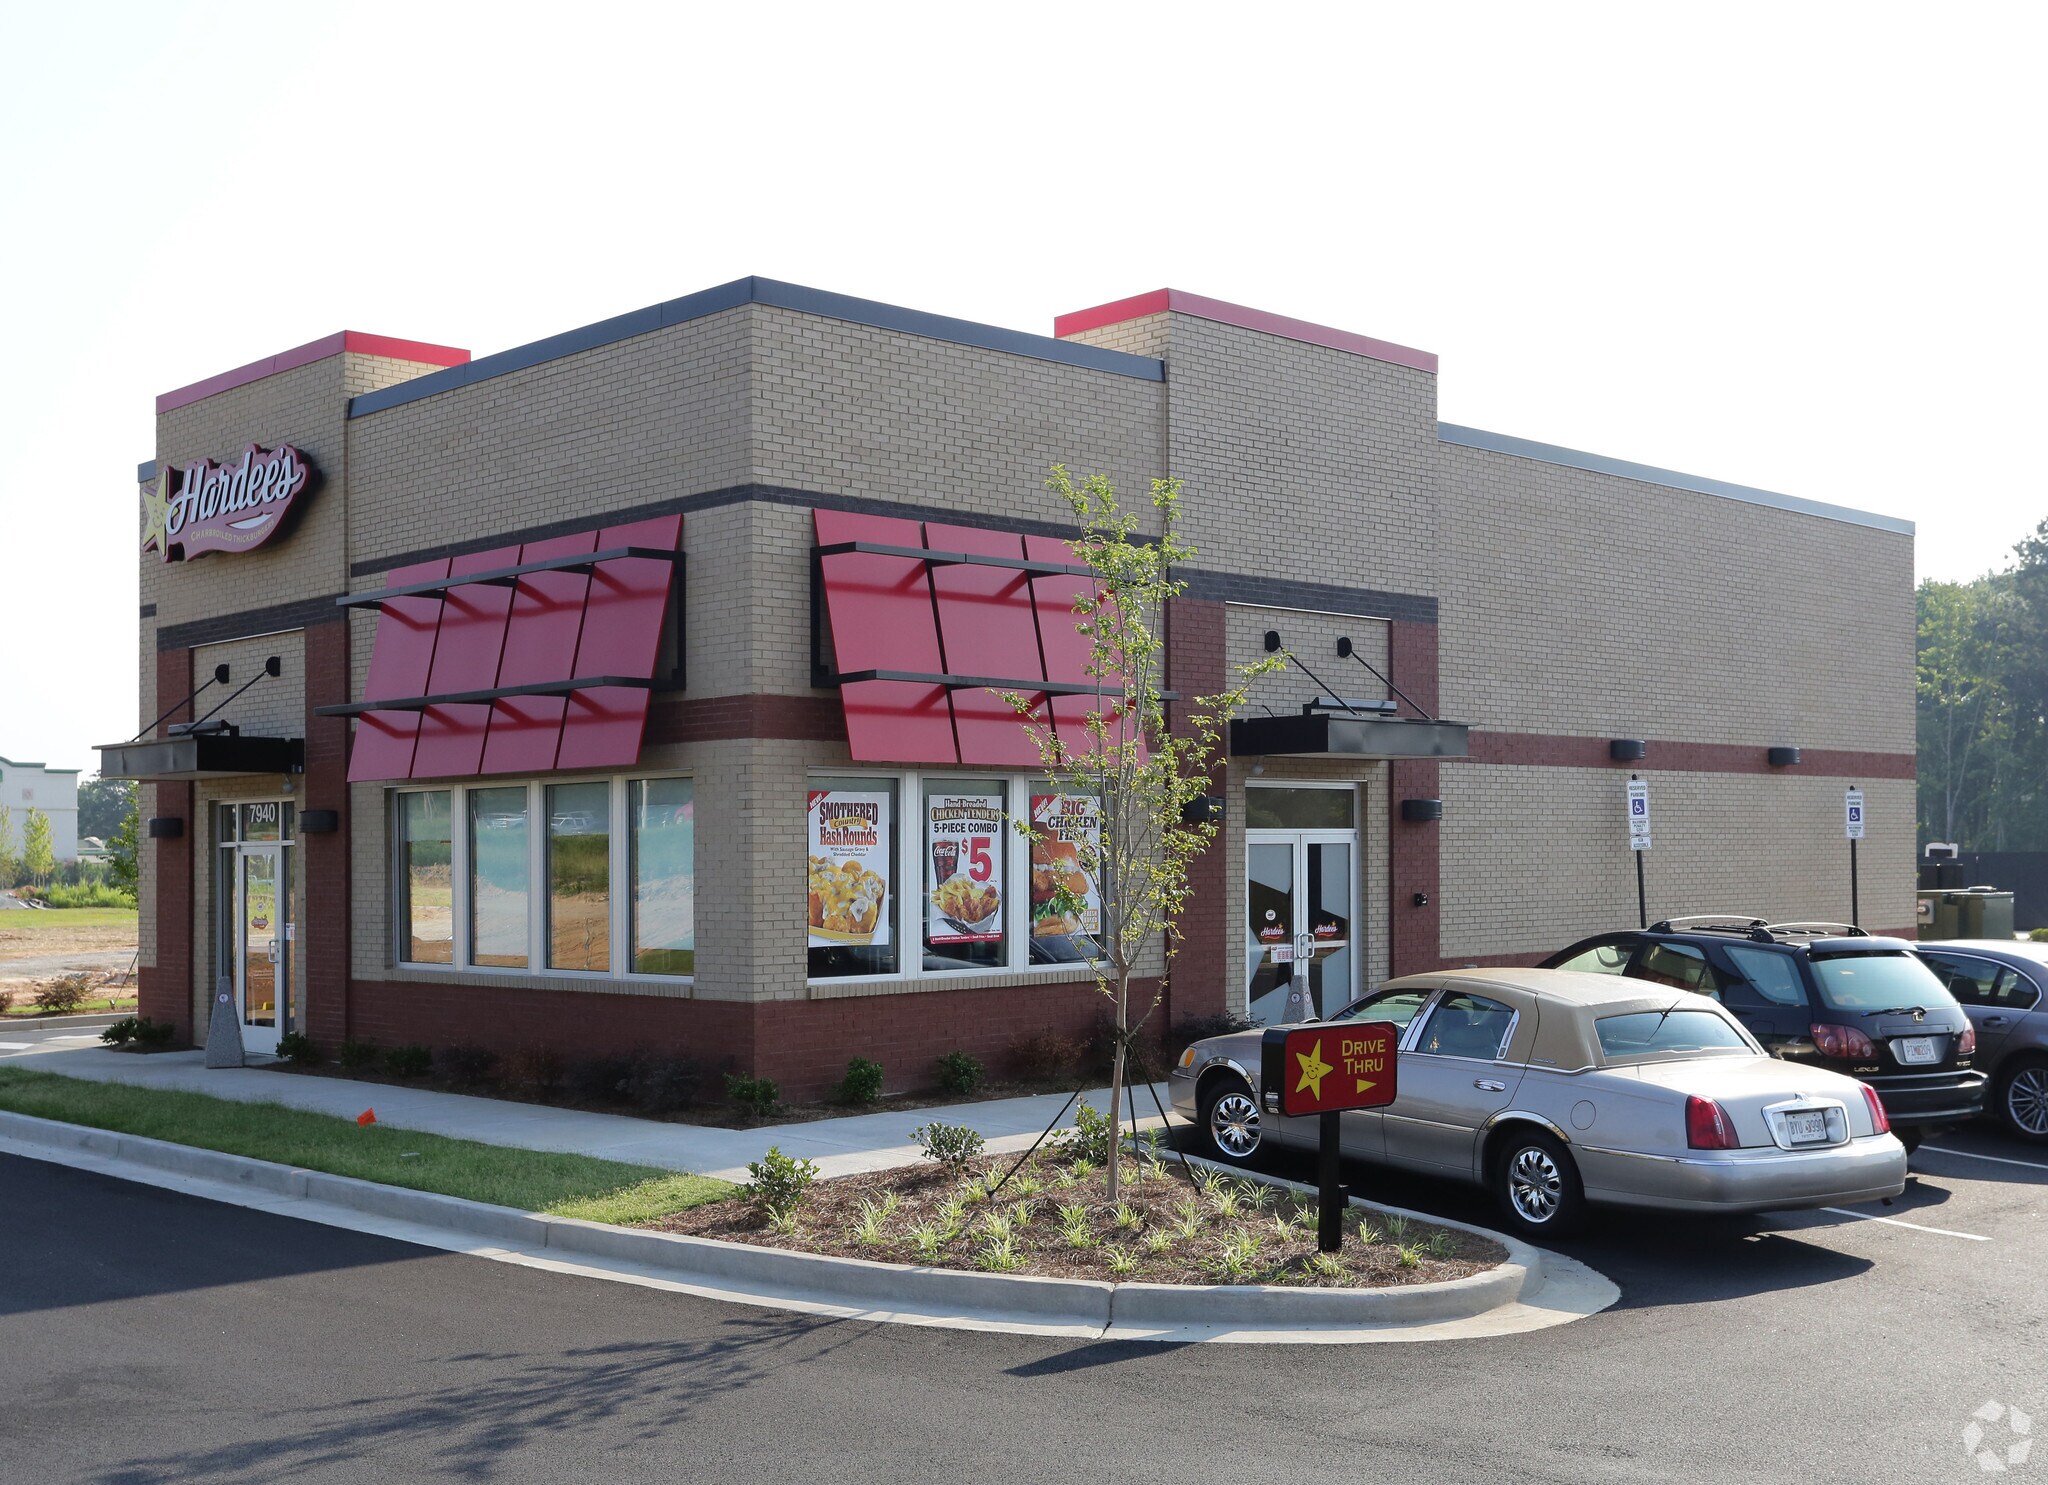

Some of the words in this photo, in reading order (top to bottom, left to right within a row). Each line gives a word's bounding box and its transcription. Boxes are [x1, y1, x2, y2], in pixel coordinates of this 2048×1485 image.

[166, 447, 303, 535] Hardee's
[191, 528, 233, 541] CHARBROILED
[233, 519, 275, 543] THICKBURGERS
[250, 803, 276, 823] 7940
[820, 802, 878, 825] SMOTHERED
[931, 808, 964, 821] CHICKEN
[964, 808, 1000, 822] TENDERS
[1061, 800, 1086, 816] BIG
[834, 818, 862, 827] Country
[934, 823, 966, 833] 5-PIECE
[968, 823, 998, 833] COMBO
[820, 826, 841, 845] Hash
[842, 826, 877, 845] Rounds
[1342, 1039, 1386, 1057] DRIVE
[1343, 1058, 1384, 1075] THRU
